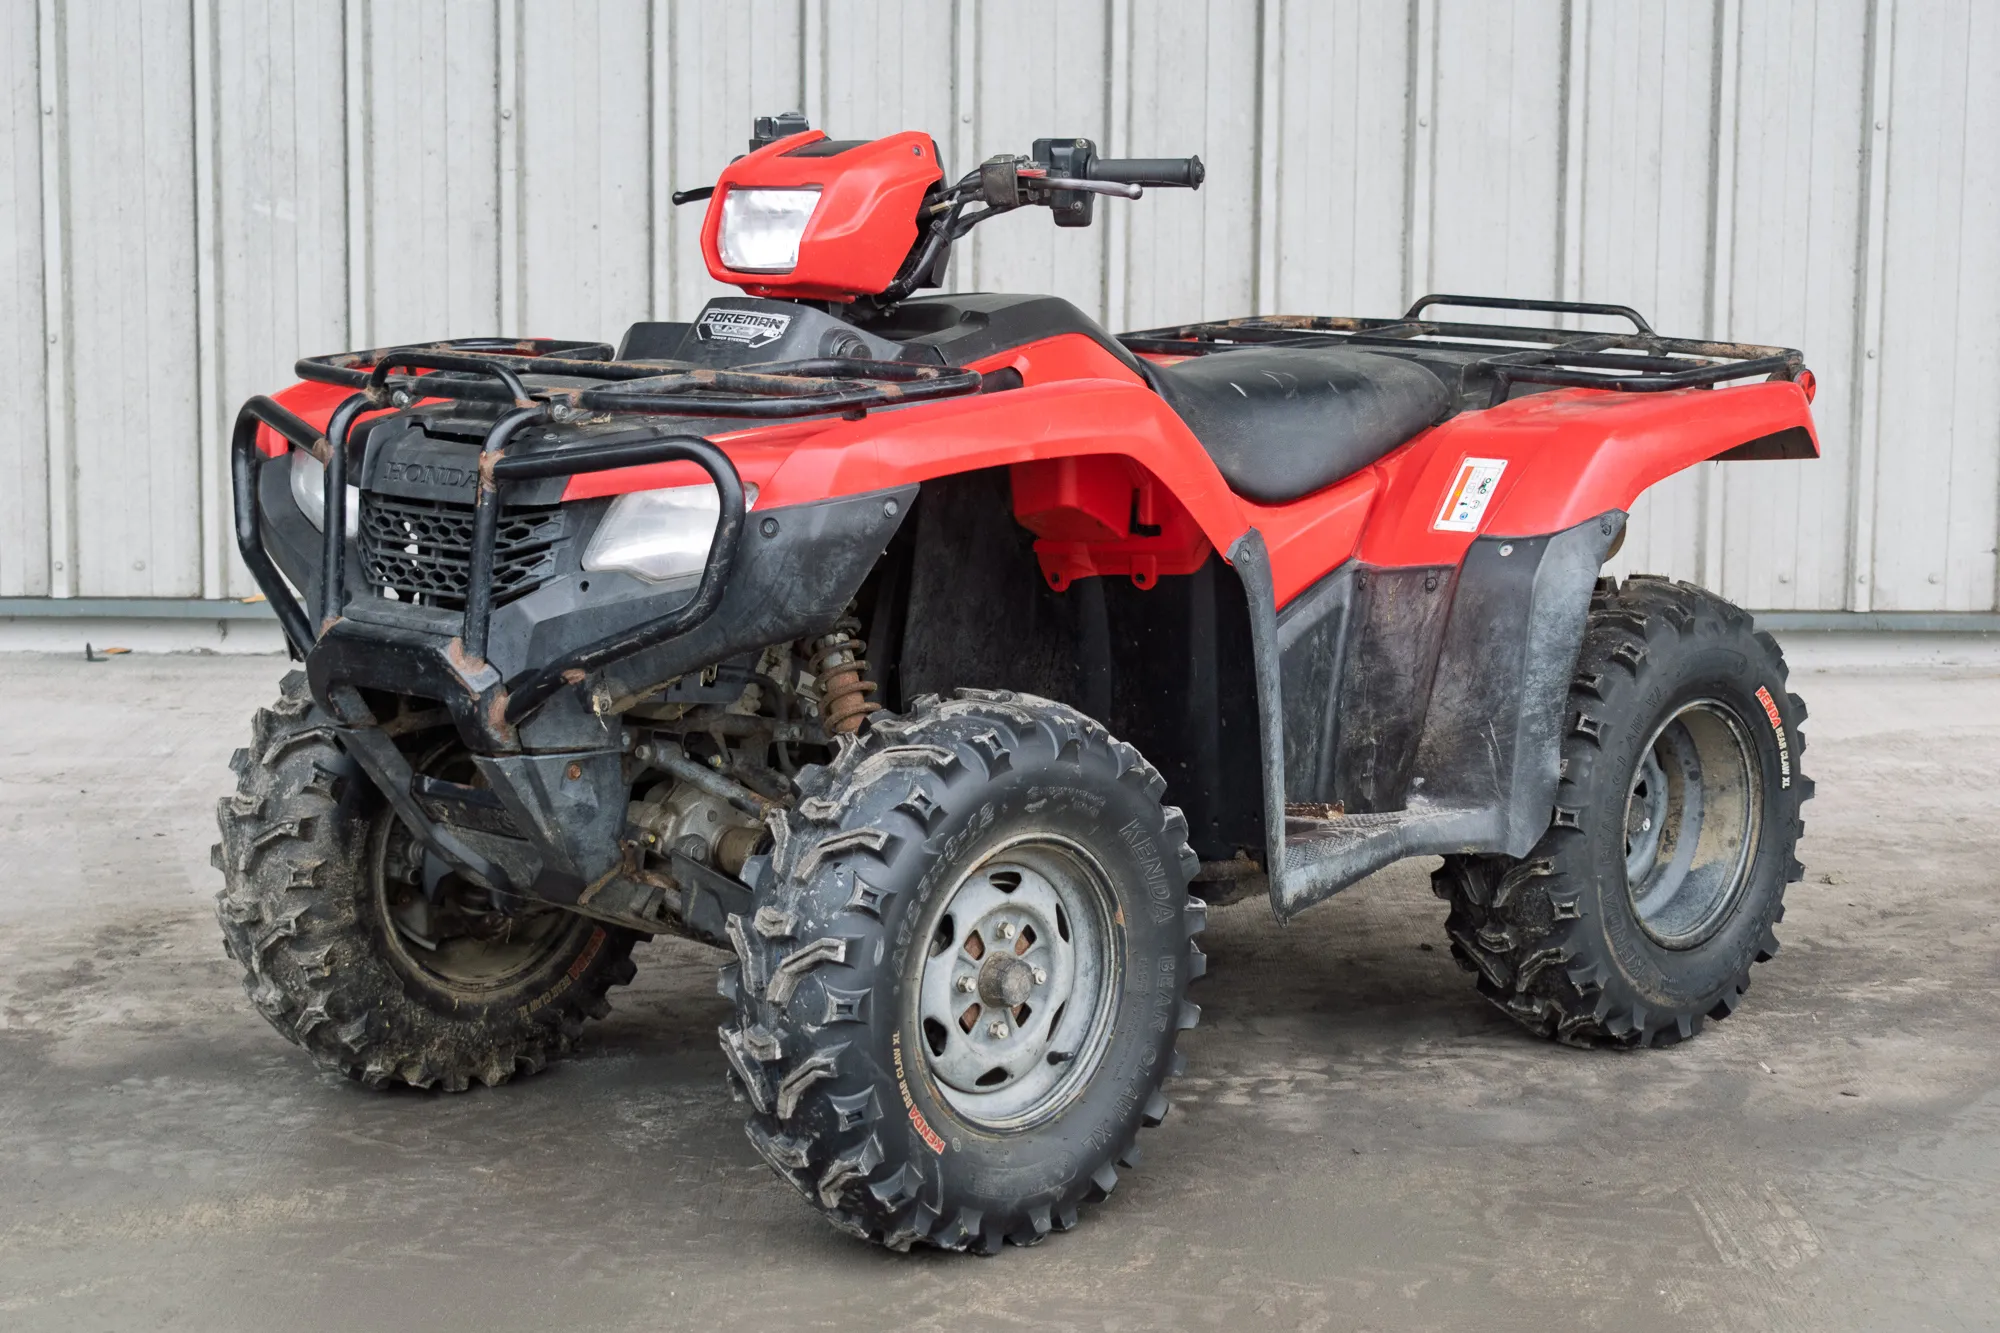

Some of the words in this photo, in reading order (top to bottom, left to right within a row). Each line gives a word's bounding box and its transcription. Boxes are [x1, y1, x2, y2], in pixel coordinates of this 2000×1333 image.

[704, 312, 785, 330] FOREMAN
[383, 460, 480, 489] HONDA
[1755, 685, 1782, 729] KENDA
[1775, 726, 1787, 750] BEAR
[1780, 750, 1790, 775] CLAW
[1782, 776, 1790, 789] XL
[1119, 818, 1175, 924] KENDA
[1149, 956, 1176, 1033] BEAR
[892, 1030, 900, 1046] XL
[893, 1048, 905, 1078] CLAW
[899, 1079, 914, 1109] BEAR
[1112, 1043, 1157, 1122] CLAW
[908, 1103, 946, 1155] KENDA
[1081, 1124, 1113, 1151] XL
